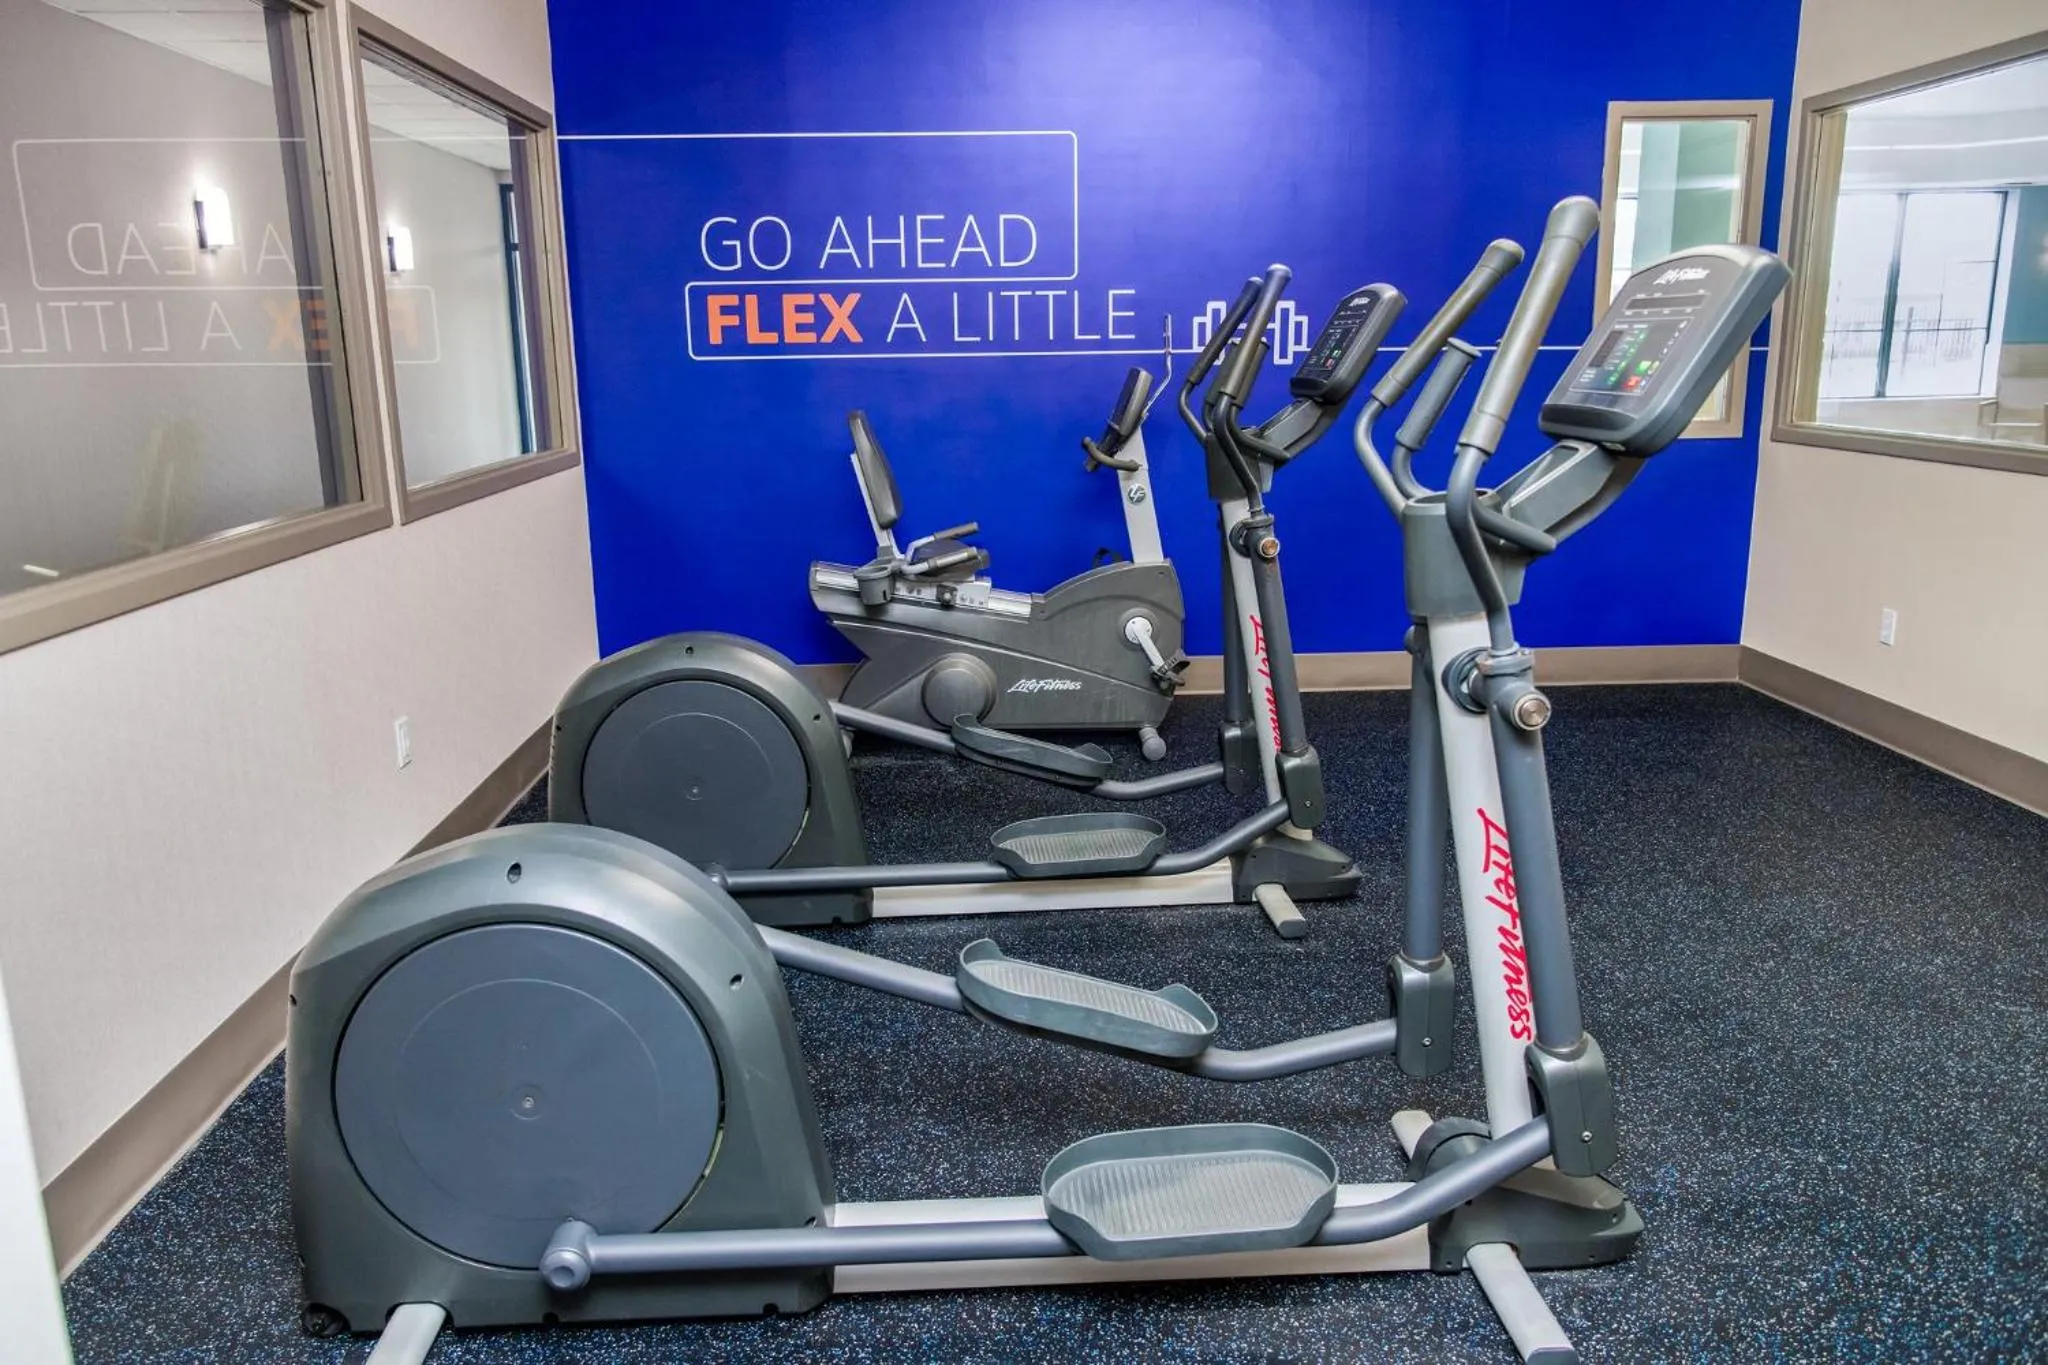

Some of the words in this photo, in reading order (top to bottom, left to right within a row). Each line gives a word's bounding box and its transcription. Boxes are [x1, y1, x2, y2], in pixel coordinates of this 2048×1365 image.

[701, 215, 792, 271] GO
[819, 214, 1037, 269] AHEAD
[706, 292, 864, 345] FLEX
[886, 291, 928, 343] A
[953, 289, 1136, 342] LITTLE
